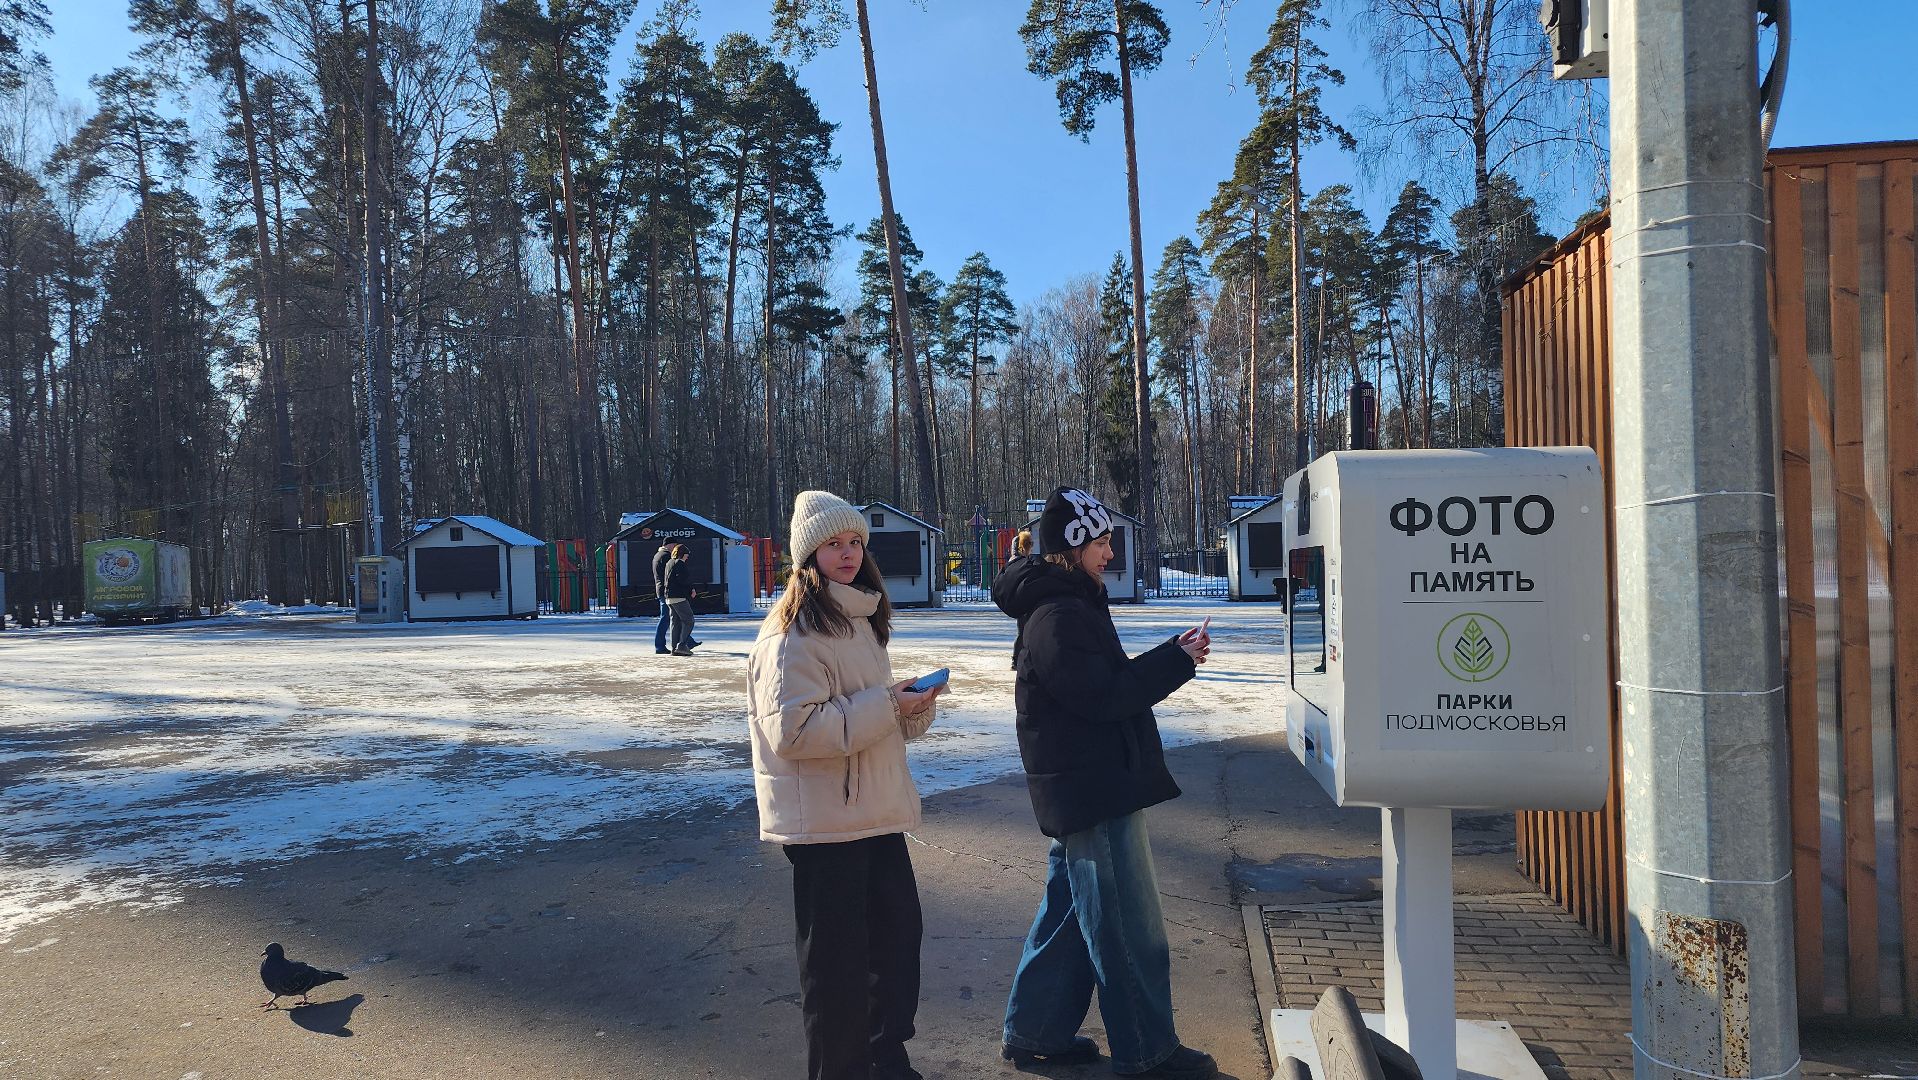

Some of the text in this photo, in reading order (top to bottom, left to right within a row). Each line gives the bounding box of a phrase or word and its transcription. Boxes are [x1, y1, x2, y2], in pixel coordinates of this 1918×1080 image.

[1389, 494, 1555, 537] ФОТО
[654, 529, 696, 538] Stardogs
[1450, 542, 1493, 564] НА
[96, 584, 143, 593] ИГРОВОЙ
[1410, 570, 1535, 593] ПАМЯТЬ
[1437, 693, 1513, 710] ПАРКИ
[1386, 714, 1567, 732] ПОДМОСКОВЬЯ
